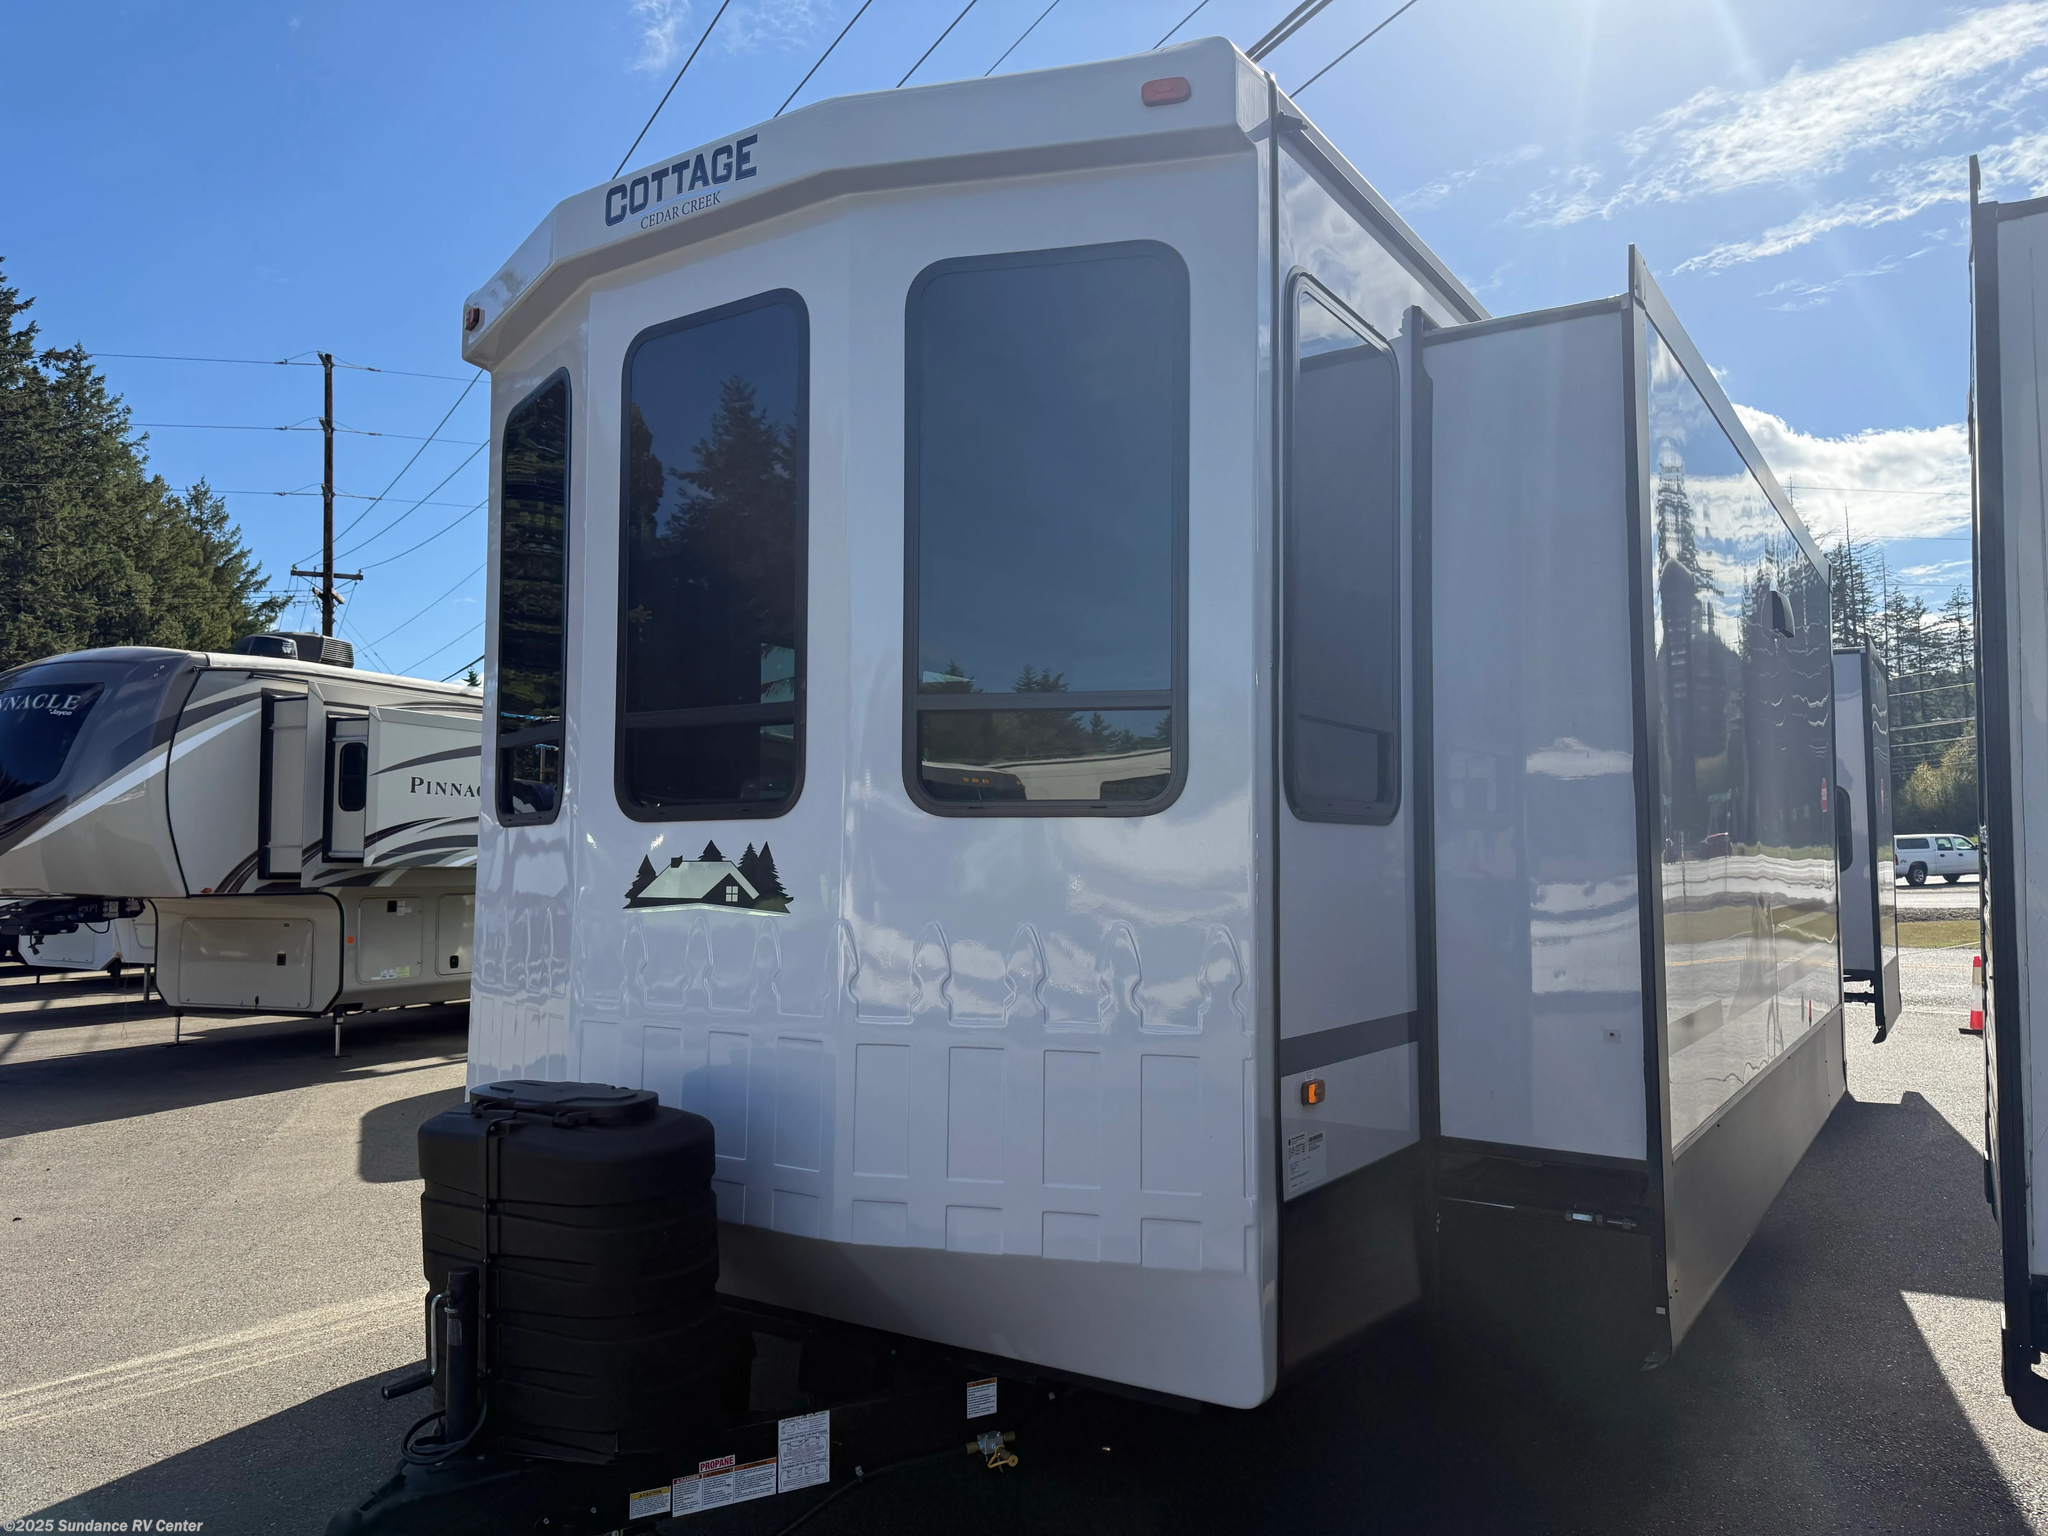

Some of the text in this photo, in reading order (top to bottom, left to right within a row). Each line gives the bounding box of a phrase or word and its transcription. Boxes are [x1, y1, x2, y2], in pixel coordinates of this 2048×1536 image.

[605, 133, 758, 227] COTTAGE
[640, 190, 721, 230] CEDAR CREEK
[700, 1456, 734, 1471] PROPANE
